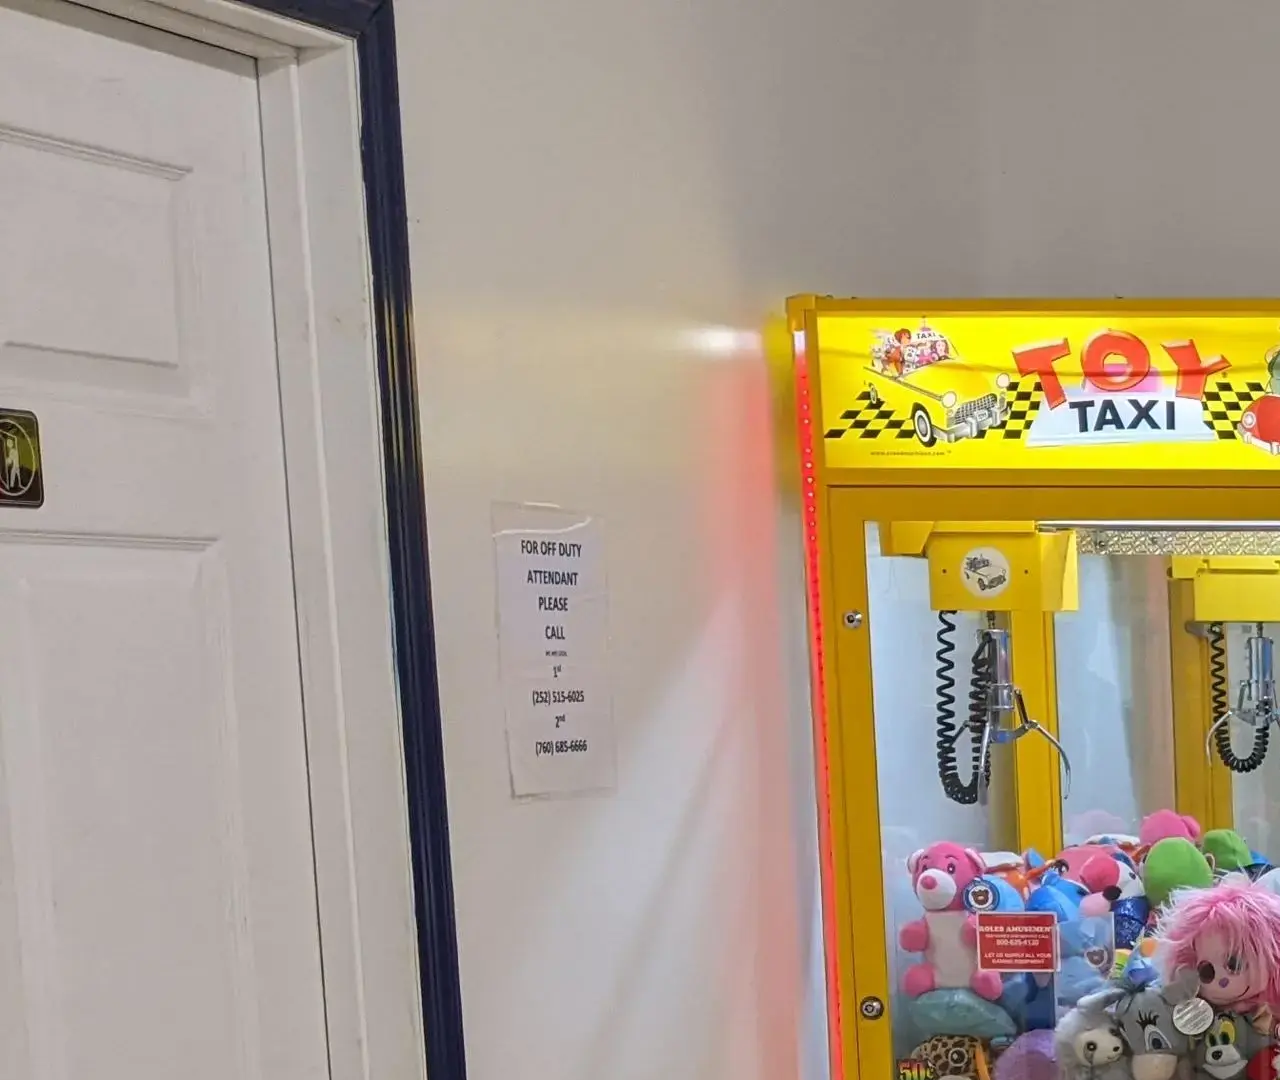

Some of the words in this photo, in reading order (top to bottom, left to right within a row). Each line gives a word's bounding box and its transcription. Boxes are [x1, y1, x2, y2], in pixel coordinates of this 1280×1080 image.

[1012, 328, 1233, 411] TOY
[1068, 399, 1176, 433] TAXI
[521, 540, 539, 555] FOR
[540, 540, 557, 556] OFF
[558, 541, 582, 558] DUTY
[527, 570, 578, 586] ATTENDANT
[538, 596, 568, 611] PLEASE
[545, 625, 565, 640] CALL
[532, 690, 551, 706] (252)
[555, 714, 566, 728] 2nd
[535, 740, 554, 756] (760)
